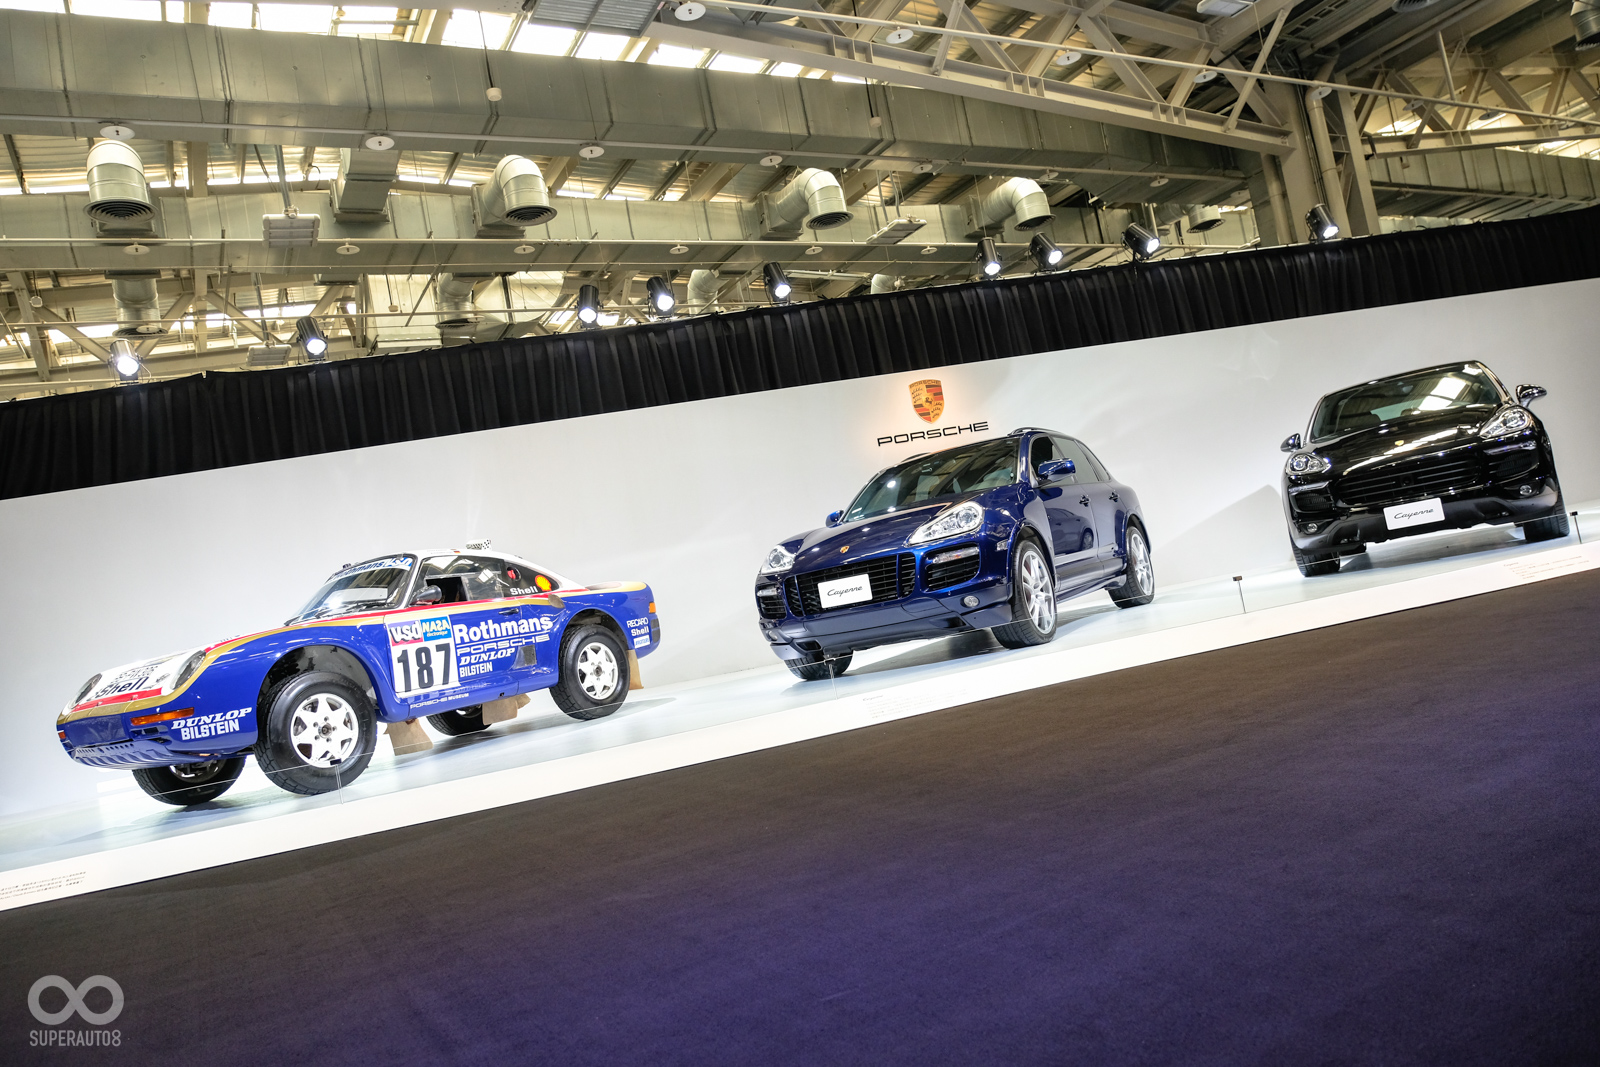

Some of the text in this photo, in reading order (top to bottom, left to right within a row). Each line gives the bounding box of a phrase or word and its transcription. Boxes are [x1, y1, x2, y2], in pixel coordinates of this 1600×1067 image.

[877, 421, 989, 447] PORSCHE
[1394, 508, 1434, 519] Cayenne
[510, 586, 538, 595] Shell
[827, 586, 863, 597] Cayenne
[453, 617, 553, 644] Rothmans
[627, 617, 648, 628] RECARO
[631, 626, 649, 636] Shell
[457, 634, 550, 656] PORSCHE
[459, 648, 515, 665] DUNLOP
[397, 643, 450, 692] 187
[460, 662, 493, 677] BILSTEIN
[95, 677, 149, 698] Shell
[410, 693, 469, 709] PORSCHE MUSEUM
[171, 707, 252, 729] DUNLOP
[181, 719, 239, 740] BILSTEIN
